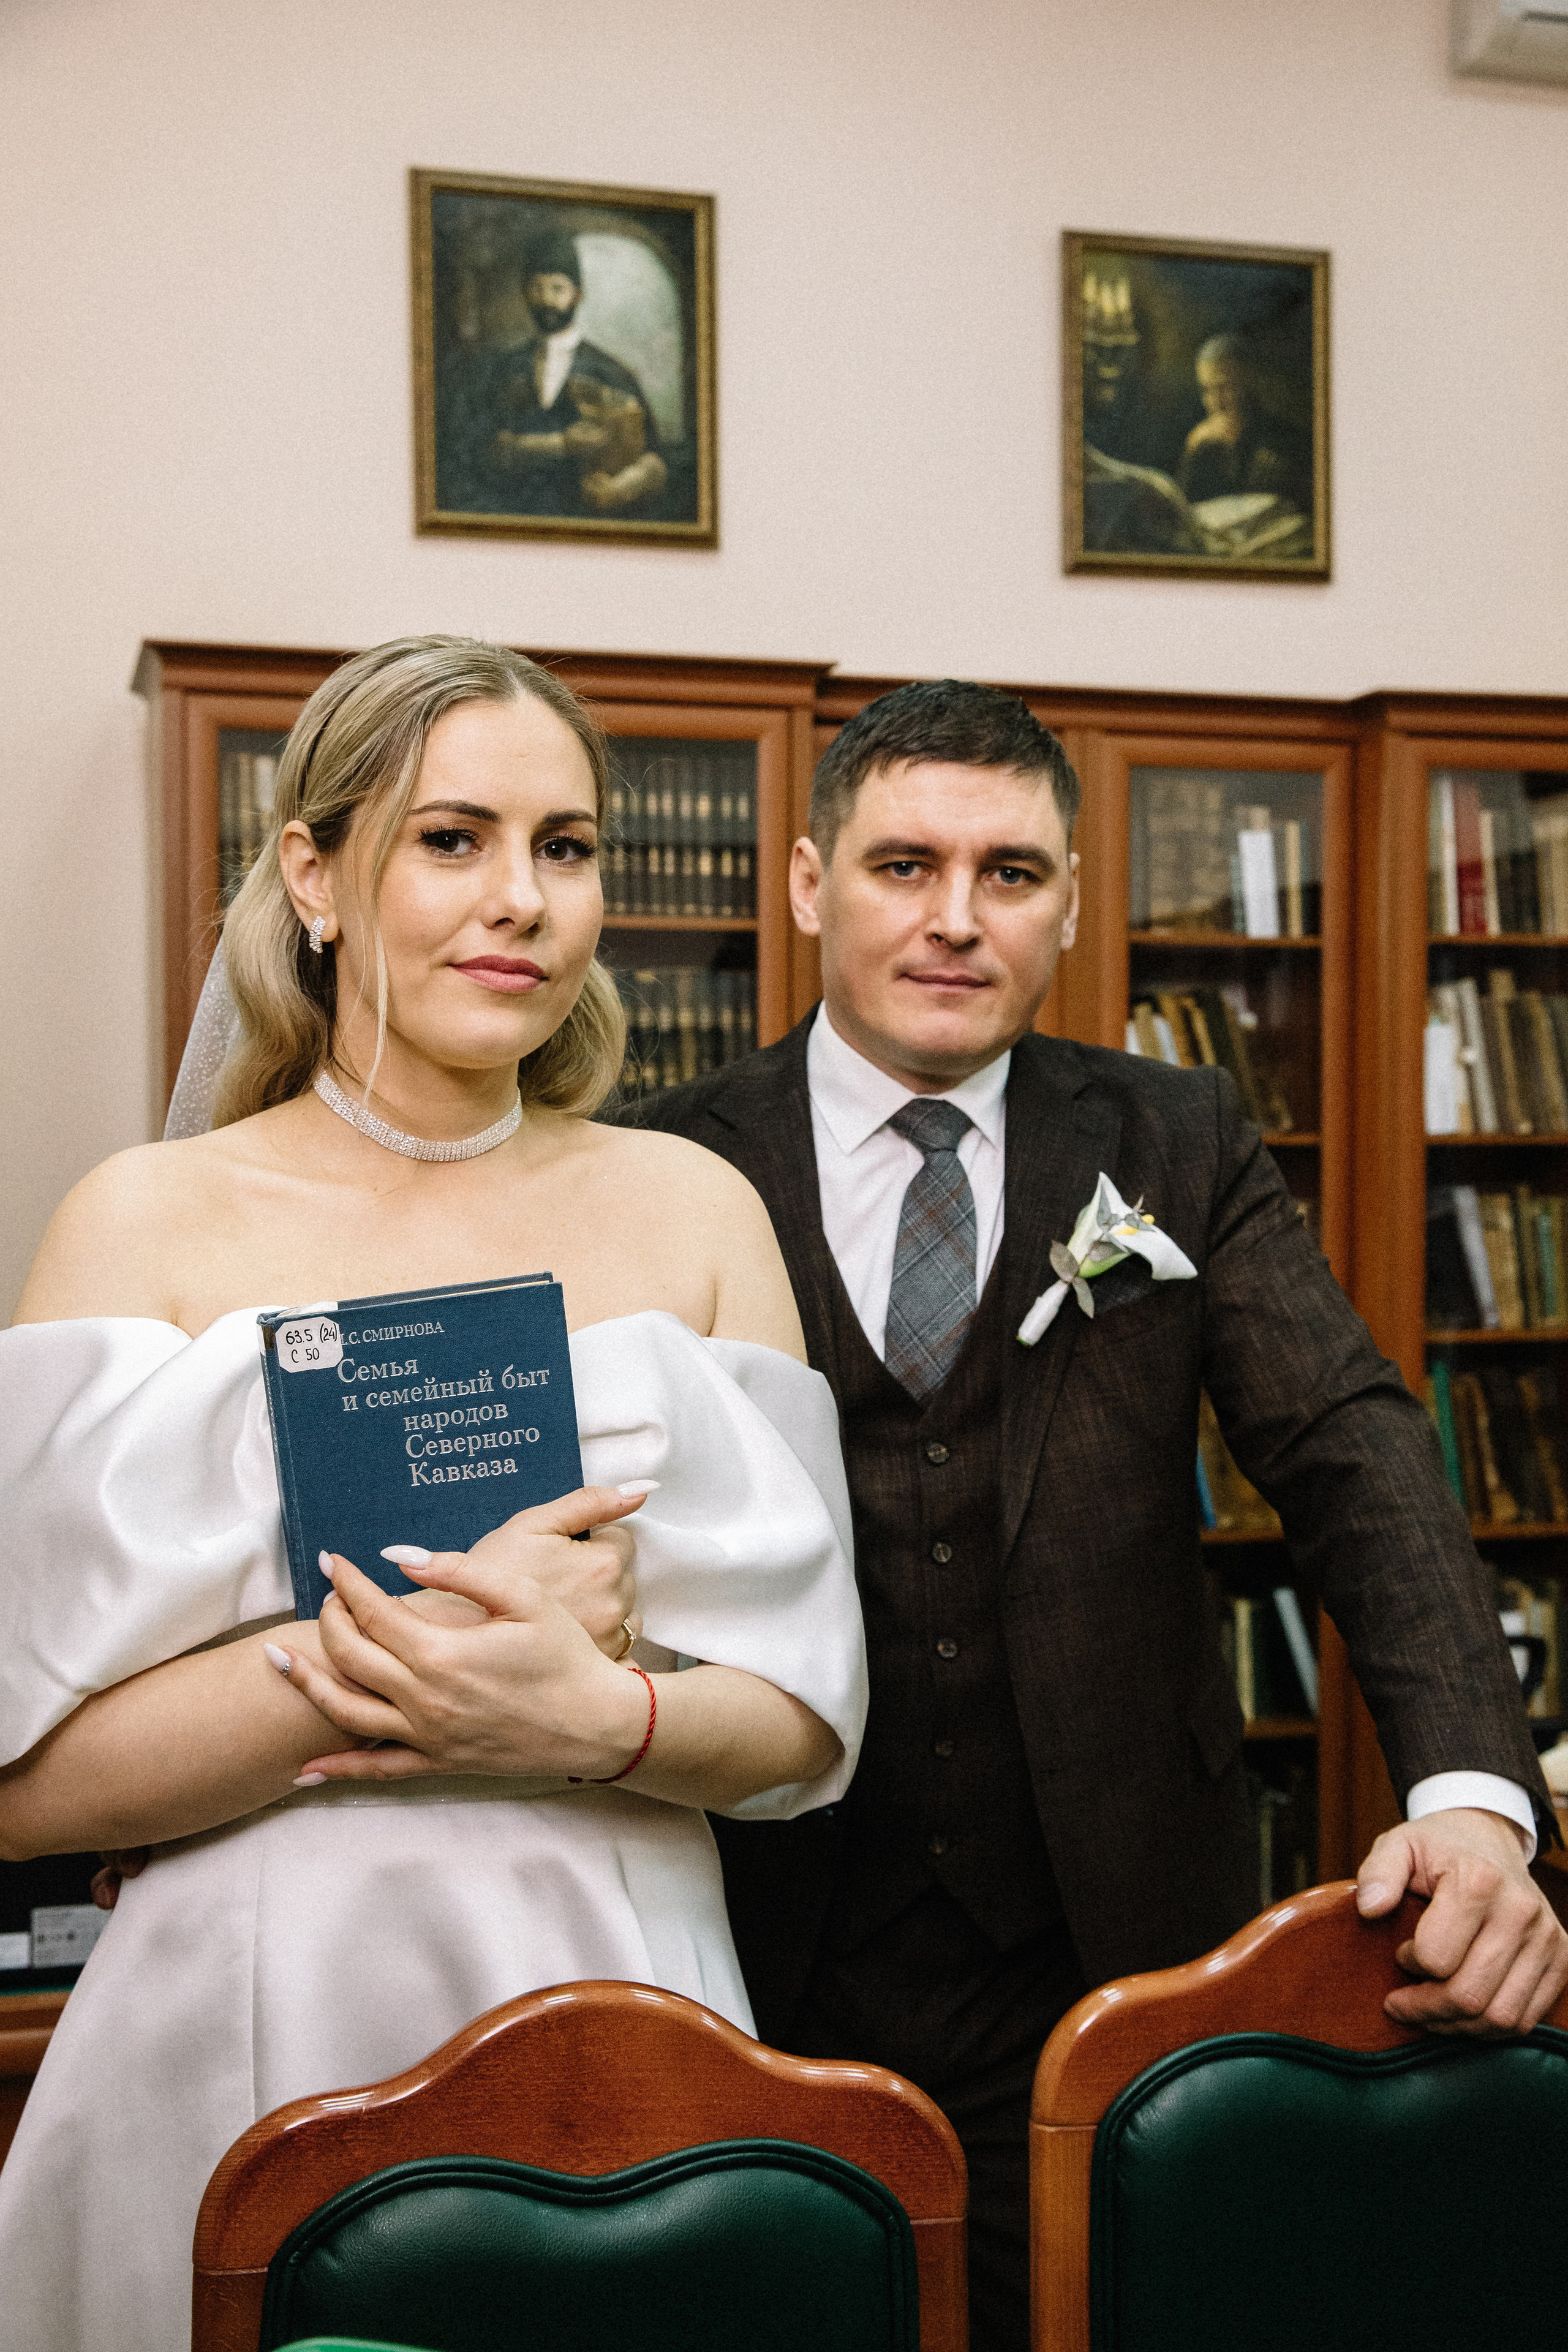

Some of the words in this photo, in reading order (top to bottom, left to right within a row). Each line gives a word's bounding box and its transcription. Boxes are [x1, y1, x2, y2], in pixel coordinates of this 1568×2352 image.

[285, 1329, 313, 1345] 63.5
[319, 1323, 337, 1343] (24)
[363, 1321, 445, 1342] СМИРНОВА
[306, 1348, 320, 1361] 50
[337, 1358, 420, 1383] Семья
[342, 1395, 359, 1411] и
[366, 1369, 494, 1408] семейный
[502, 1364, 550, 1389] быт
[403, 1403, 509, 1433] народов
[405, 1428, 540, 1458] Северного
[408, 1458, 519, 1487] Кавказа
